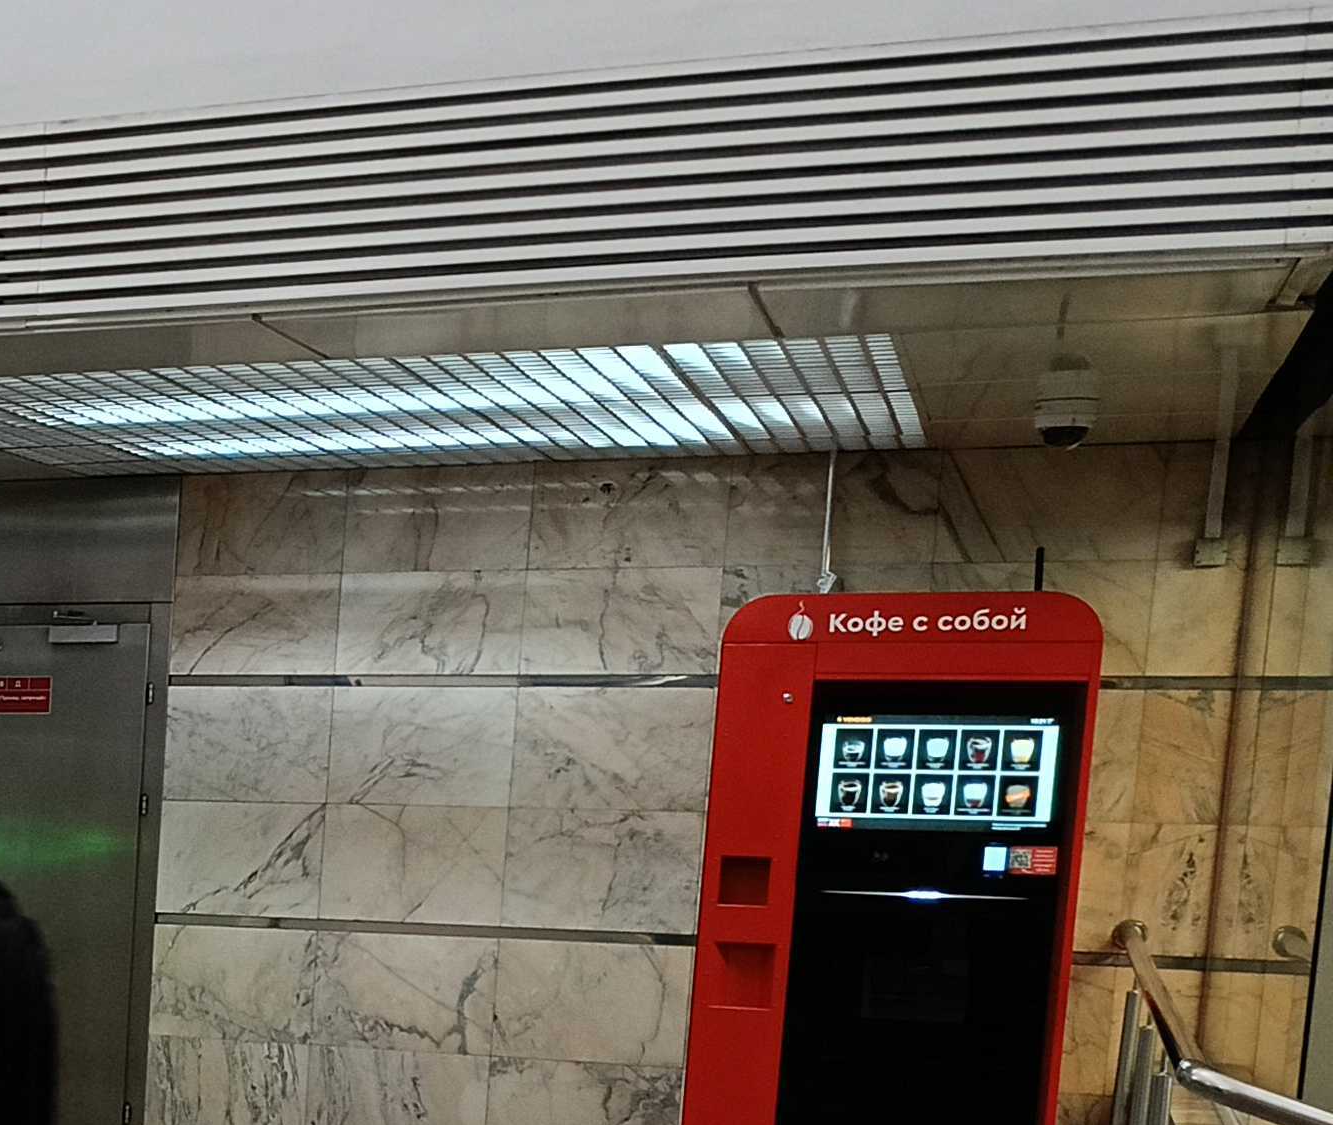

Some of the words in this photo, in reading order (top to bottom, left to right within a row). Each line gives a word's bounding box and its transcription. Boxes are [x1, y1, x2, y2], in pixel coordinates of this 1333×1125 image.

[828, 610, 904, 637] Кофе
[912, 615, 929, 631] с
[937, 607, 1027, 631] собой
